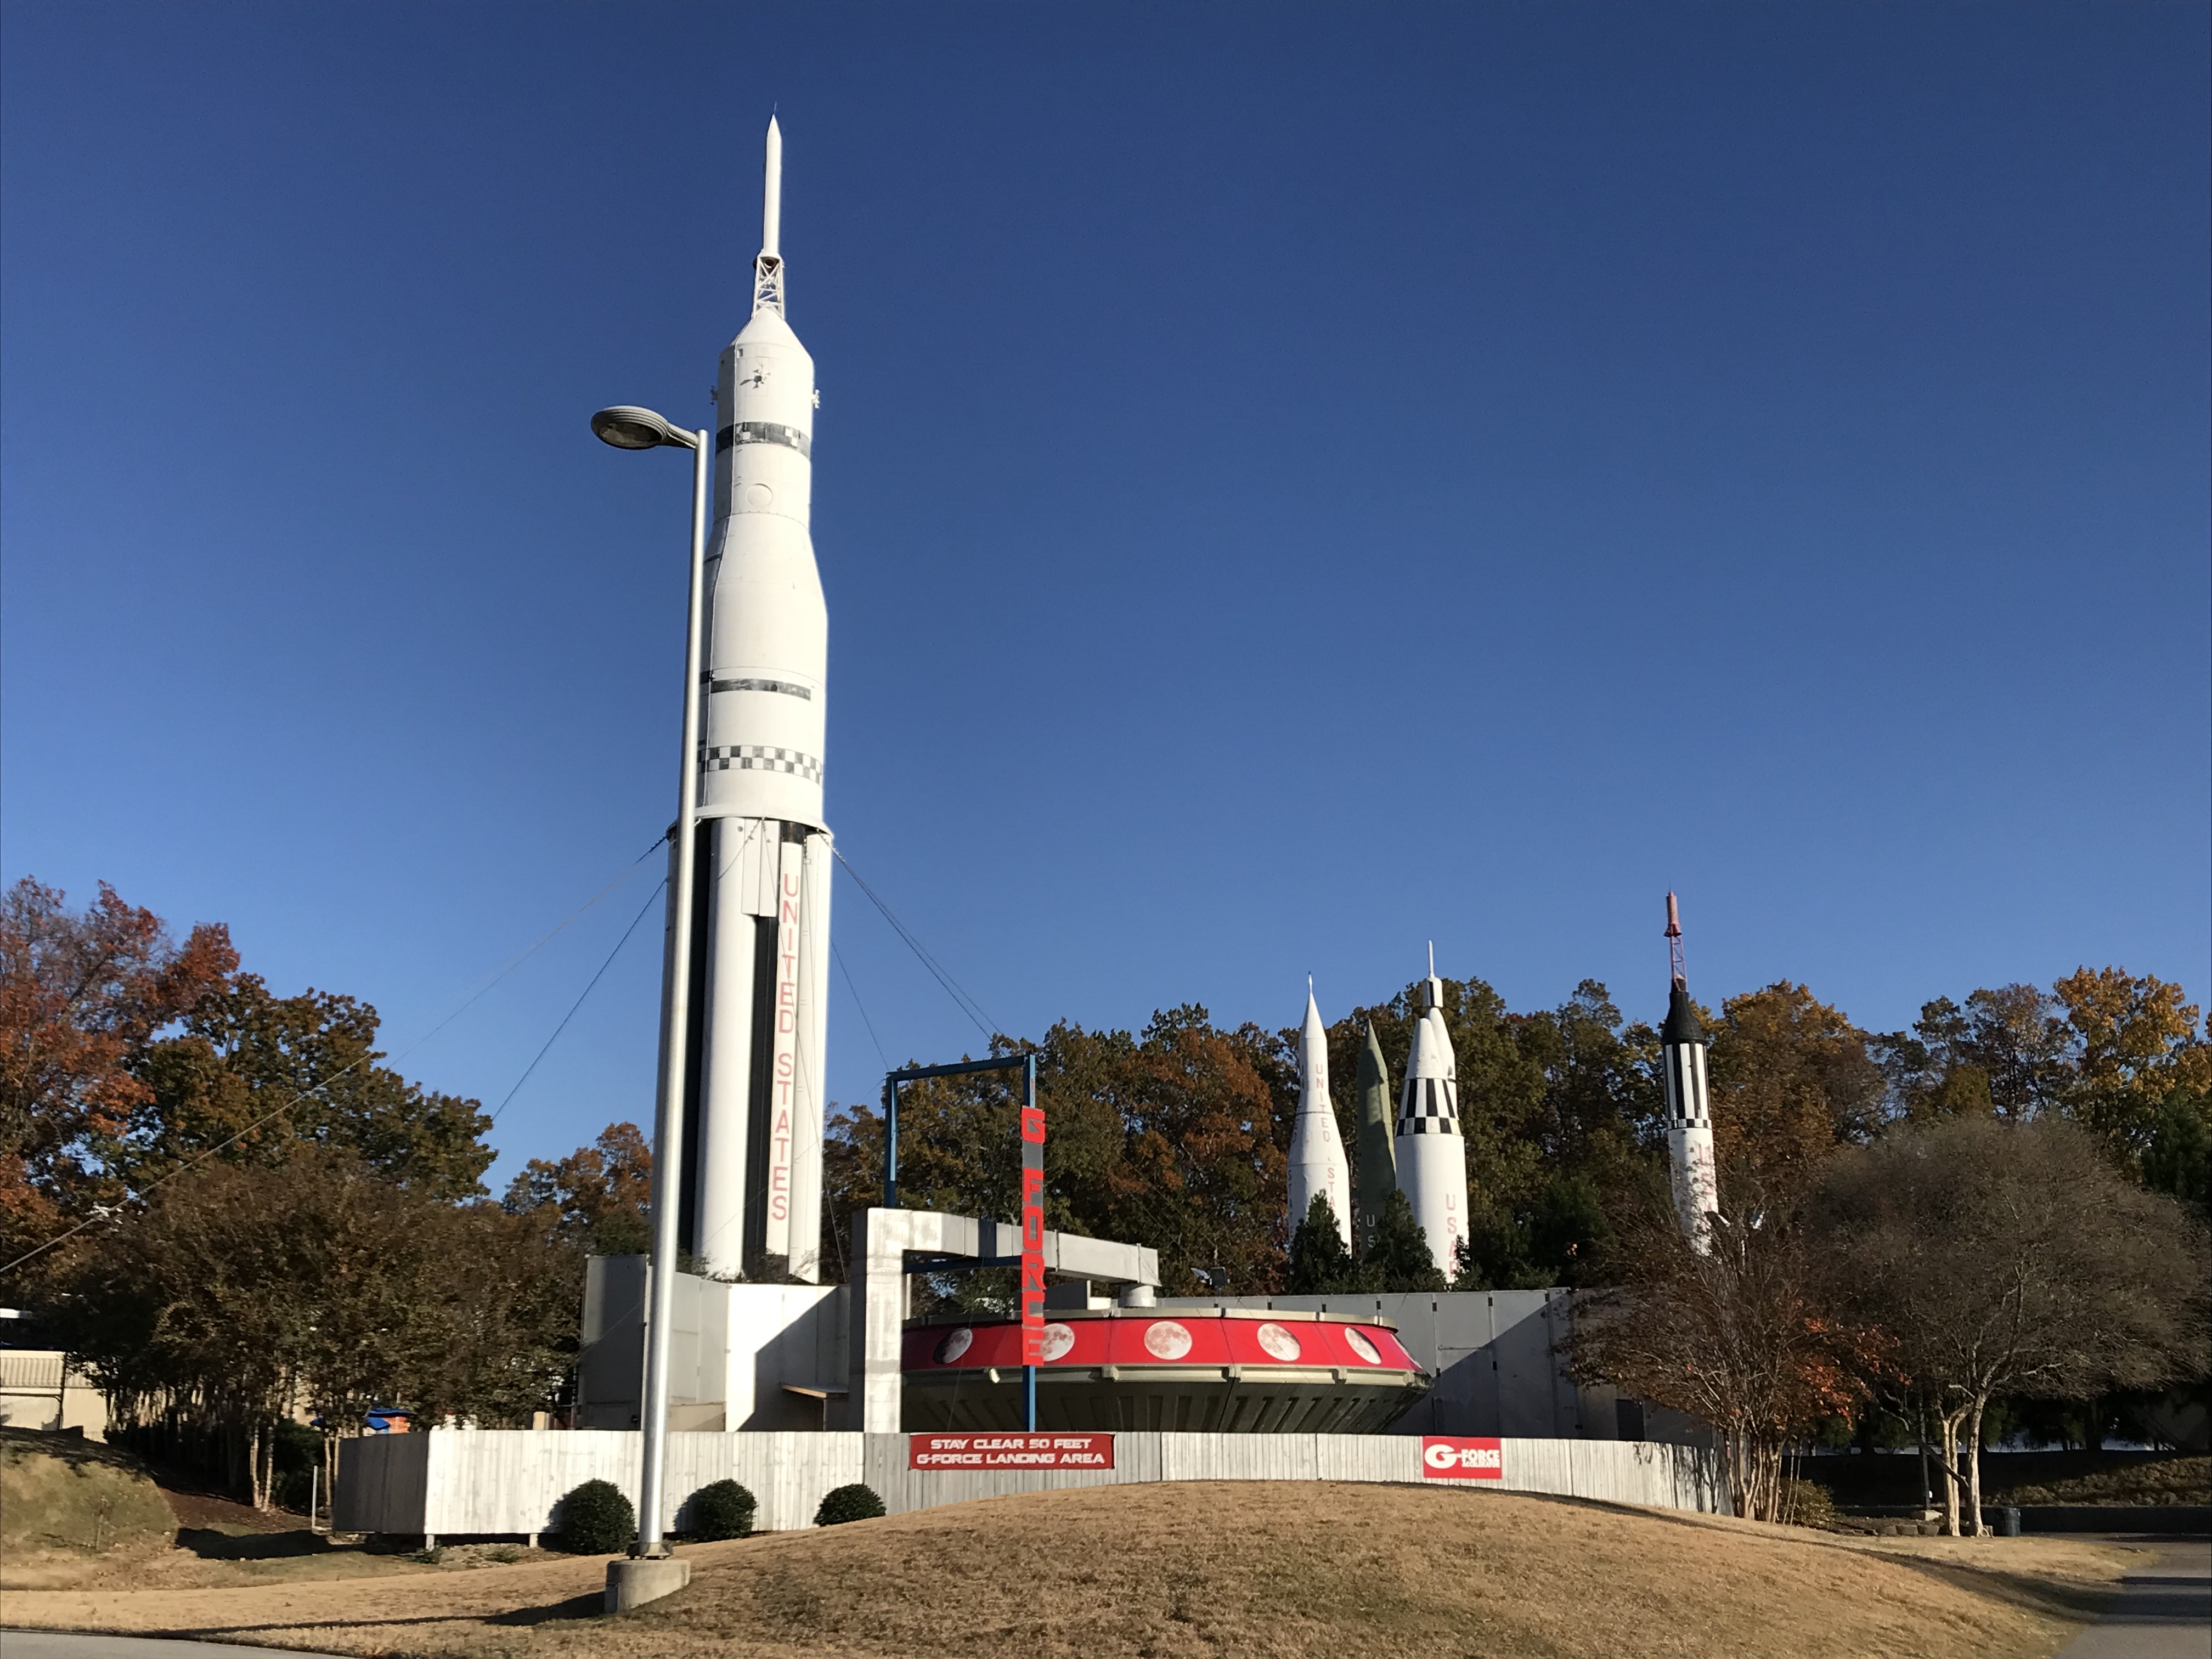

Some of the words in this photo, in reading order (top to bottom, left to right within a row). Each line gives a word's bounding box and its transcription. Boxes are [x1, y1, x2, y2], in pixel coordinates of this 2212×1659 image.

[778, 873, 799, 1034] UNITED
[771, 1053, 792, 1221] STATES
[1316, 1063, 1331, 1143] UNITED
[1327, 1167, 1335, 1207] STA
[1022, 1167, 1045, 1366] FORCE
[916, 1453, 983, 1464] G-FORCE
[986, 1453, 1056, 1464] LANDING
[1059, 1453, 1105, 1464] AREA
[930, 1438, 970, 1449] STAY
[973, 1438, 1025, 1449] CLEAR
[1029, 1438, 1050, 1449] 50
[1054, 1437, 1092, 1449] FEET
[1425, 1444, 1500, 1469] G-FORCE
